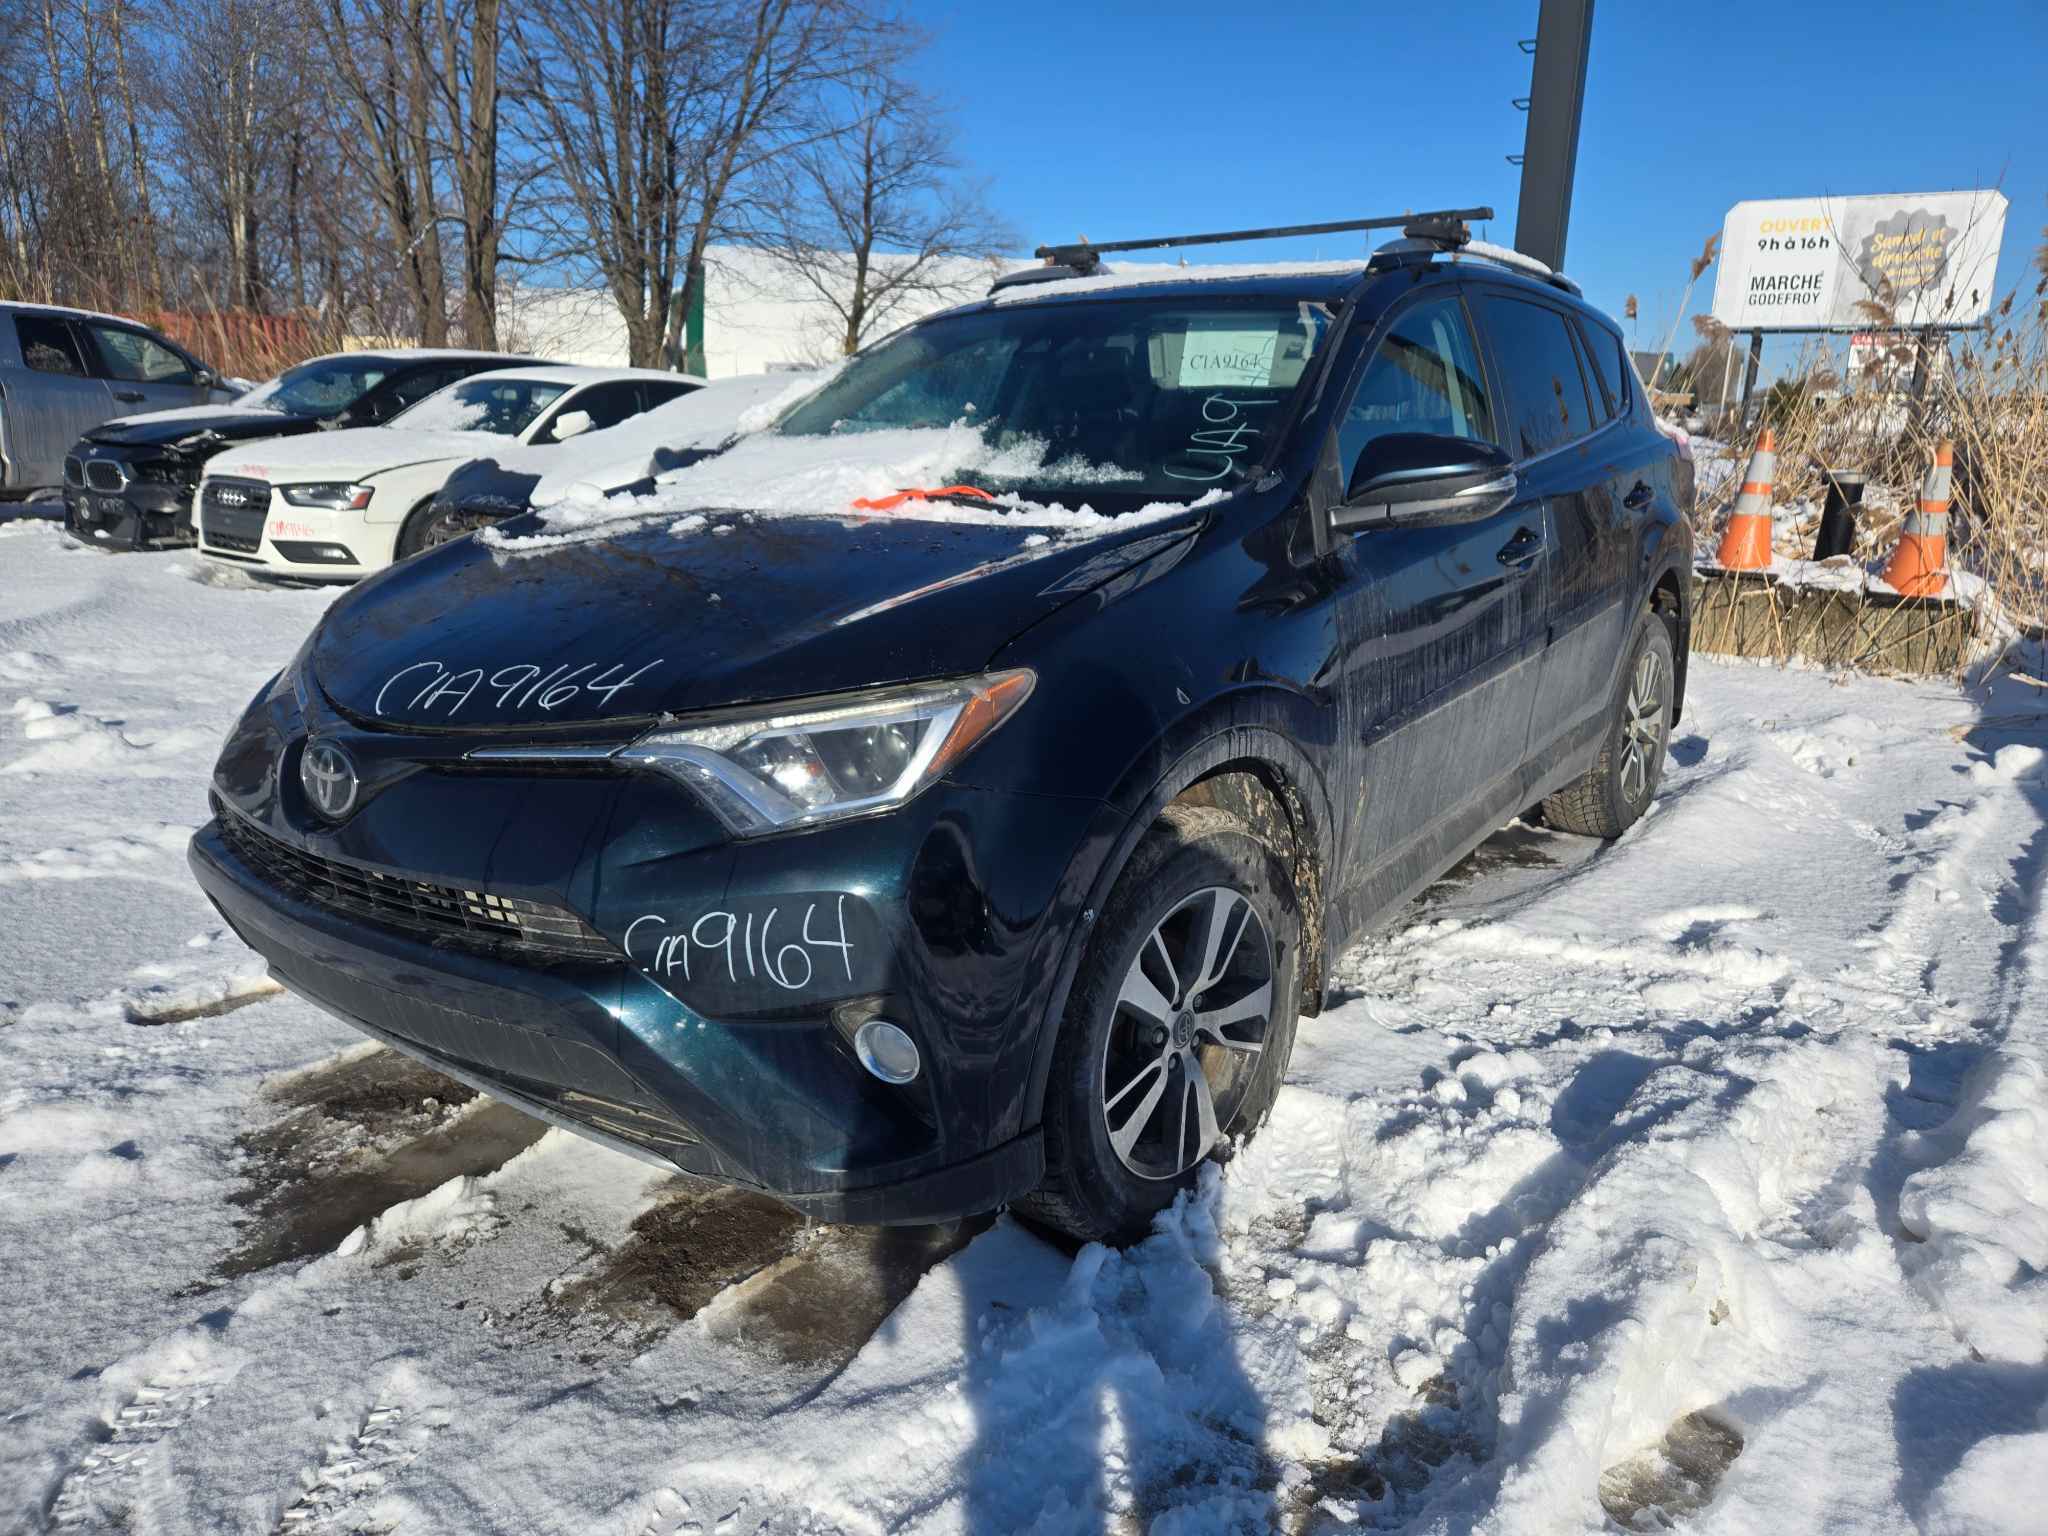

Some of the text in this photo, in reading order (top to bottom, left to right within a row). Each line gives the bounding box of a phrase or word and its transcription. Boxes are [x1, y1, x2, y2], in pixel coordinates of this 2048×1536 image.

[1759, 216, 1831, 234] OUVERT
[1758, 238, 1780, 251] 9h
[1801, 235, 1829, 250] 16h
[1748, 292, 1820, 305] GODEFROY
